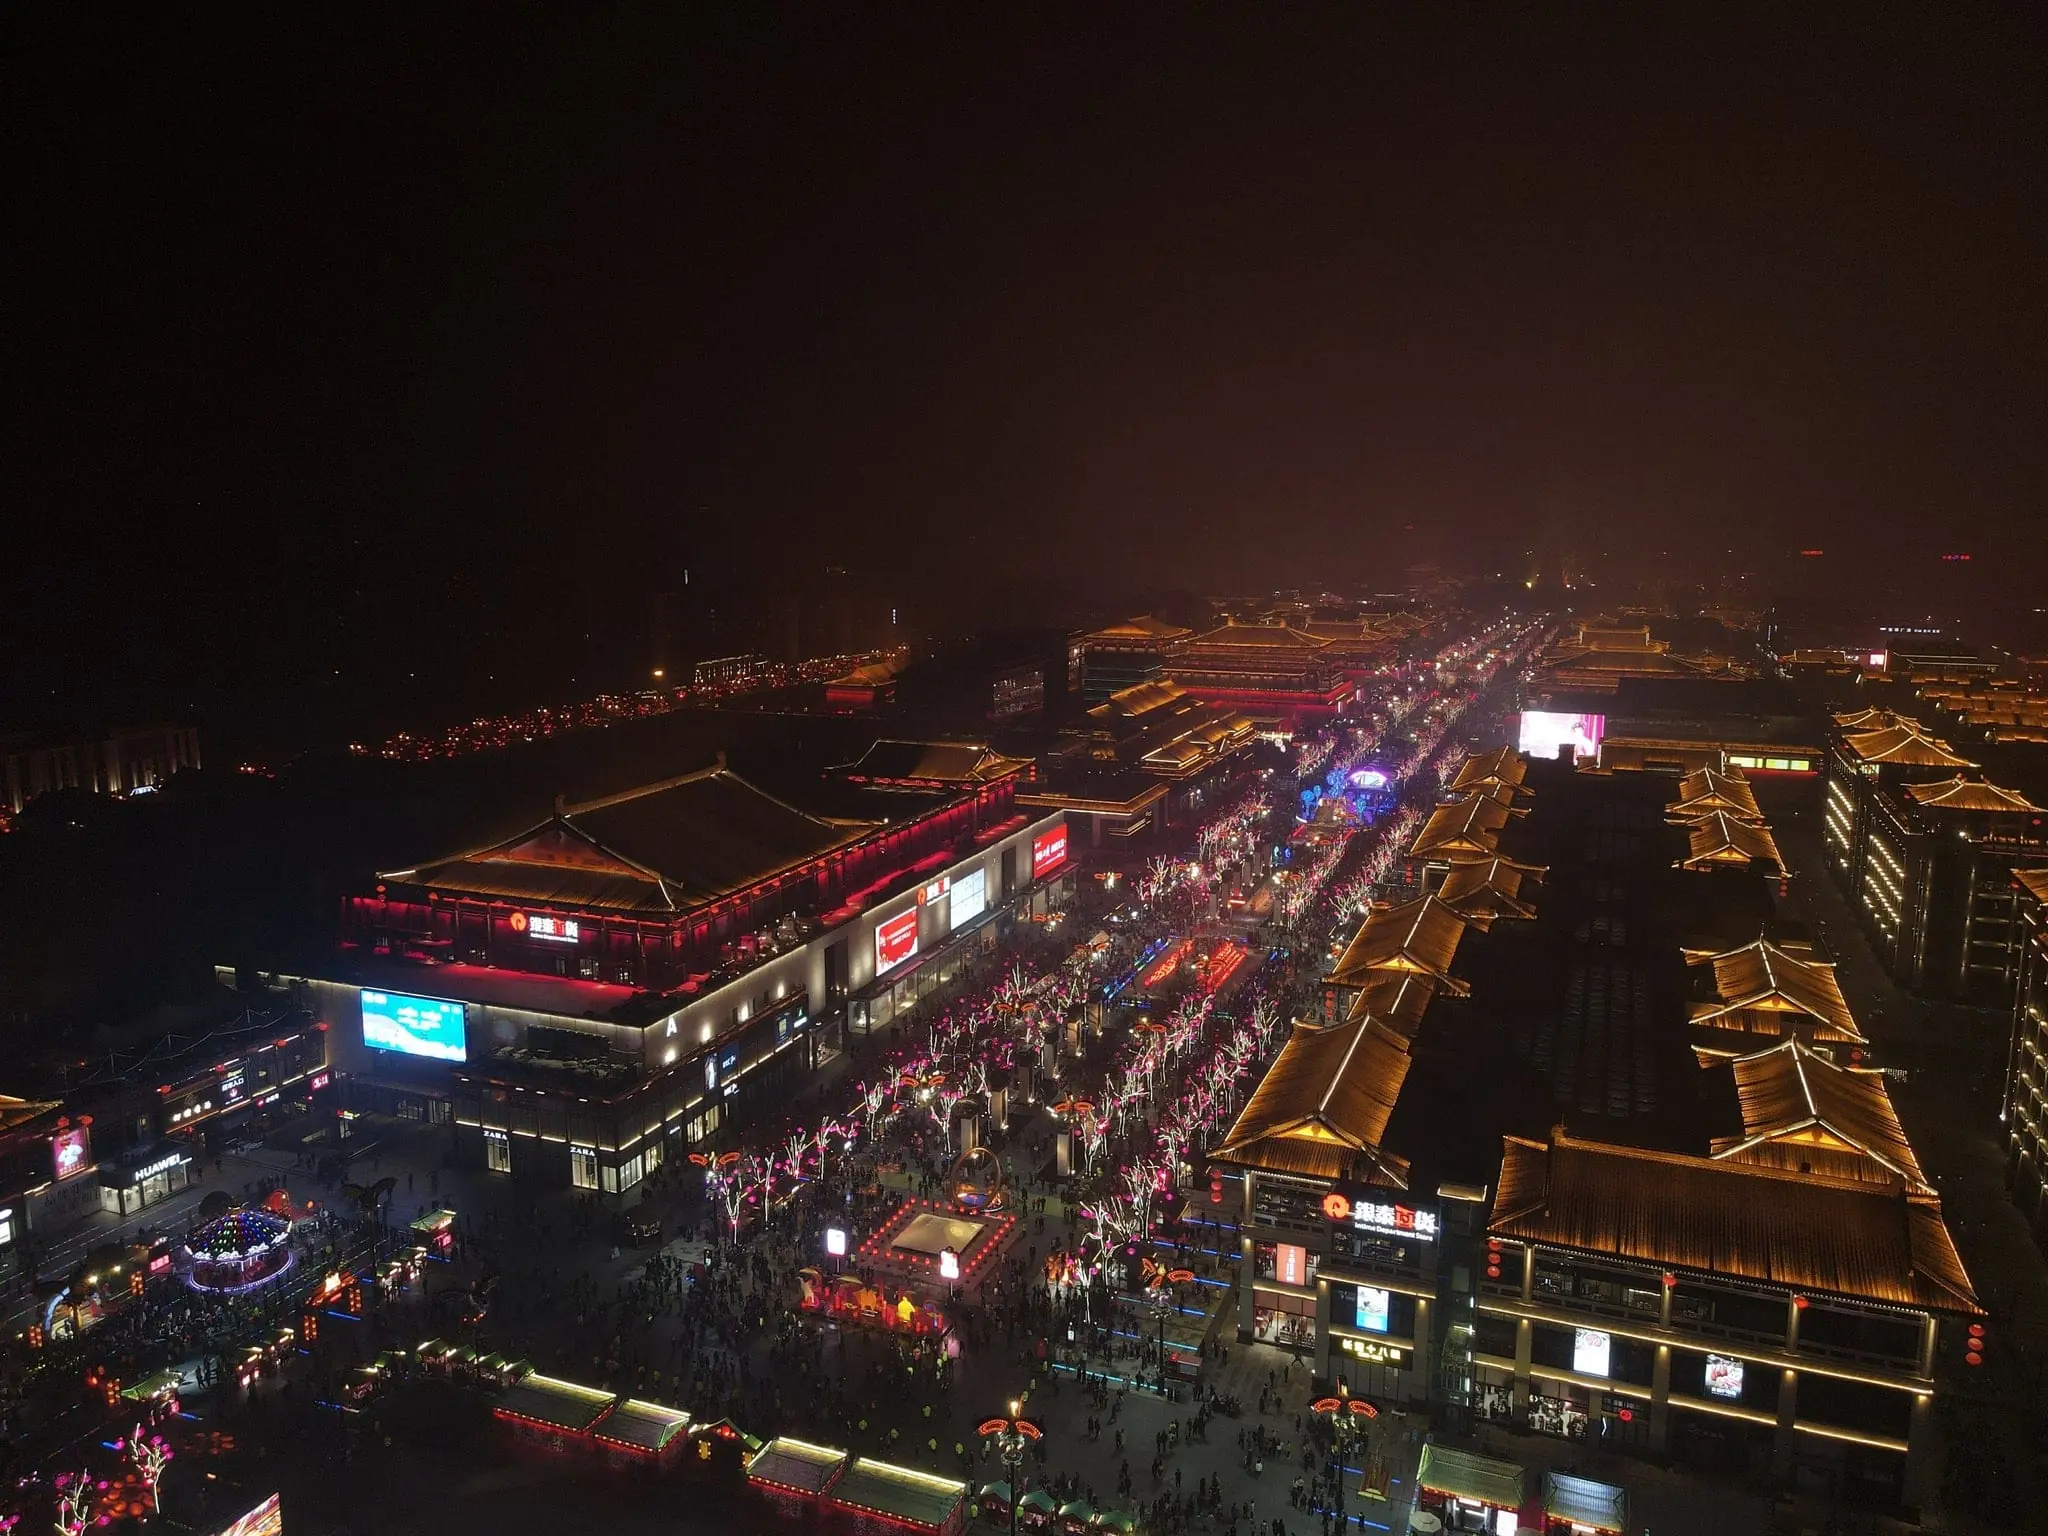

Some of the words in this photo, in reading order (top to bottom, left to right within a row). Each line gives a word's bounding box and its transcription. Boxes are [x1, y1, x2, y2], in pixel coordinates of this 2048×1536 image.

[666, 1016, 678, 1037] A
[484, 1130, 508, 1140] ZARA
[570, 1146, 596, 1157] ZARA
[135, 1153, 180, 1181] HUAWEI
